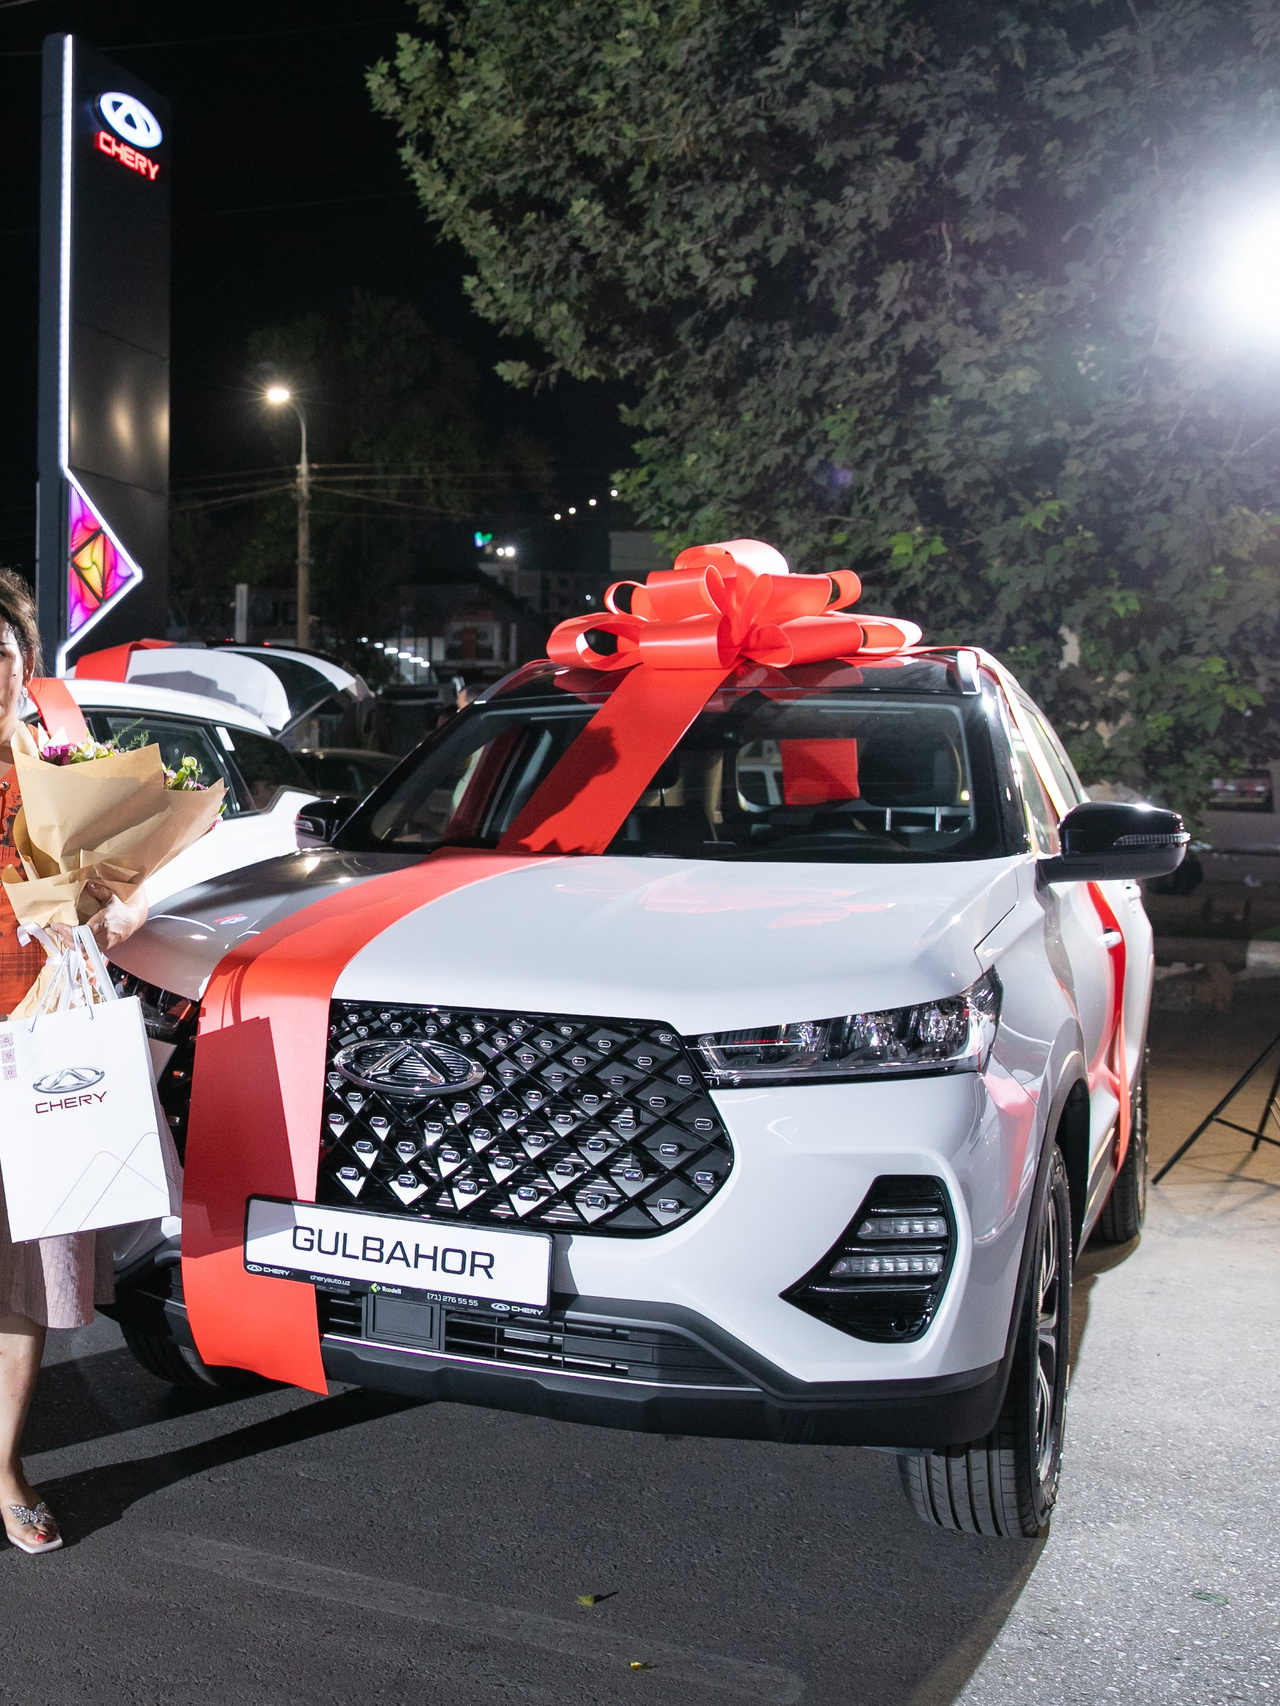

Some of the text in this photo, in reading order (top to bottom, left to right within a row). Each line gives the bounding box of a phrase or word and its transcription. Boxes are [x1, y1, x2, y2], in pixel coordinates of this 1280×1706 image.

[96, 130, 160, 181] CHERY
[35, 1091, 107, 1114] CHERY
[292, 1224, 495, 1280] GULBAHOR
[263, 1266, 290, 1276] CHERY
[309, 1274, 351, 1287] cheryauto.uz
[427, 1292, 479, 1307] (71) 276 55 55
[511, 1306, 544, 1317] CHERY
